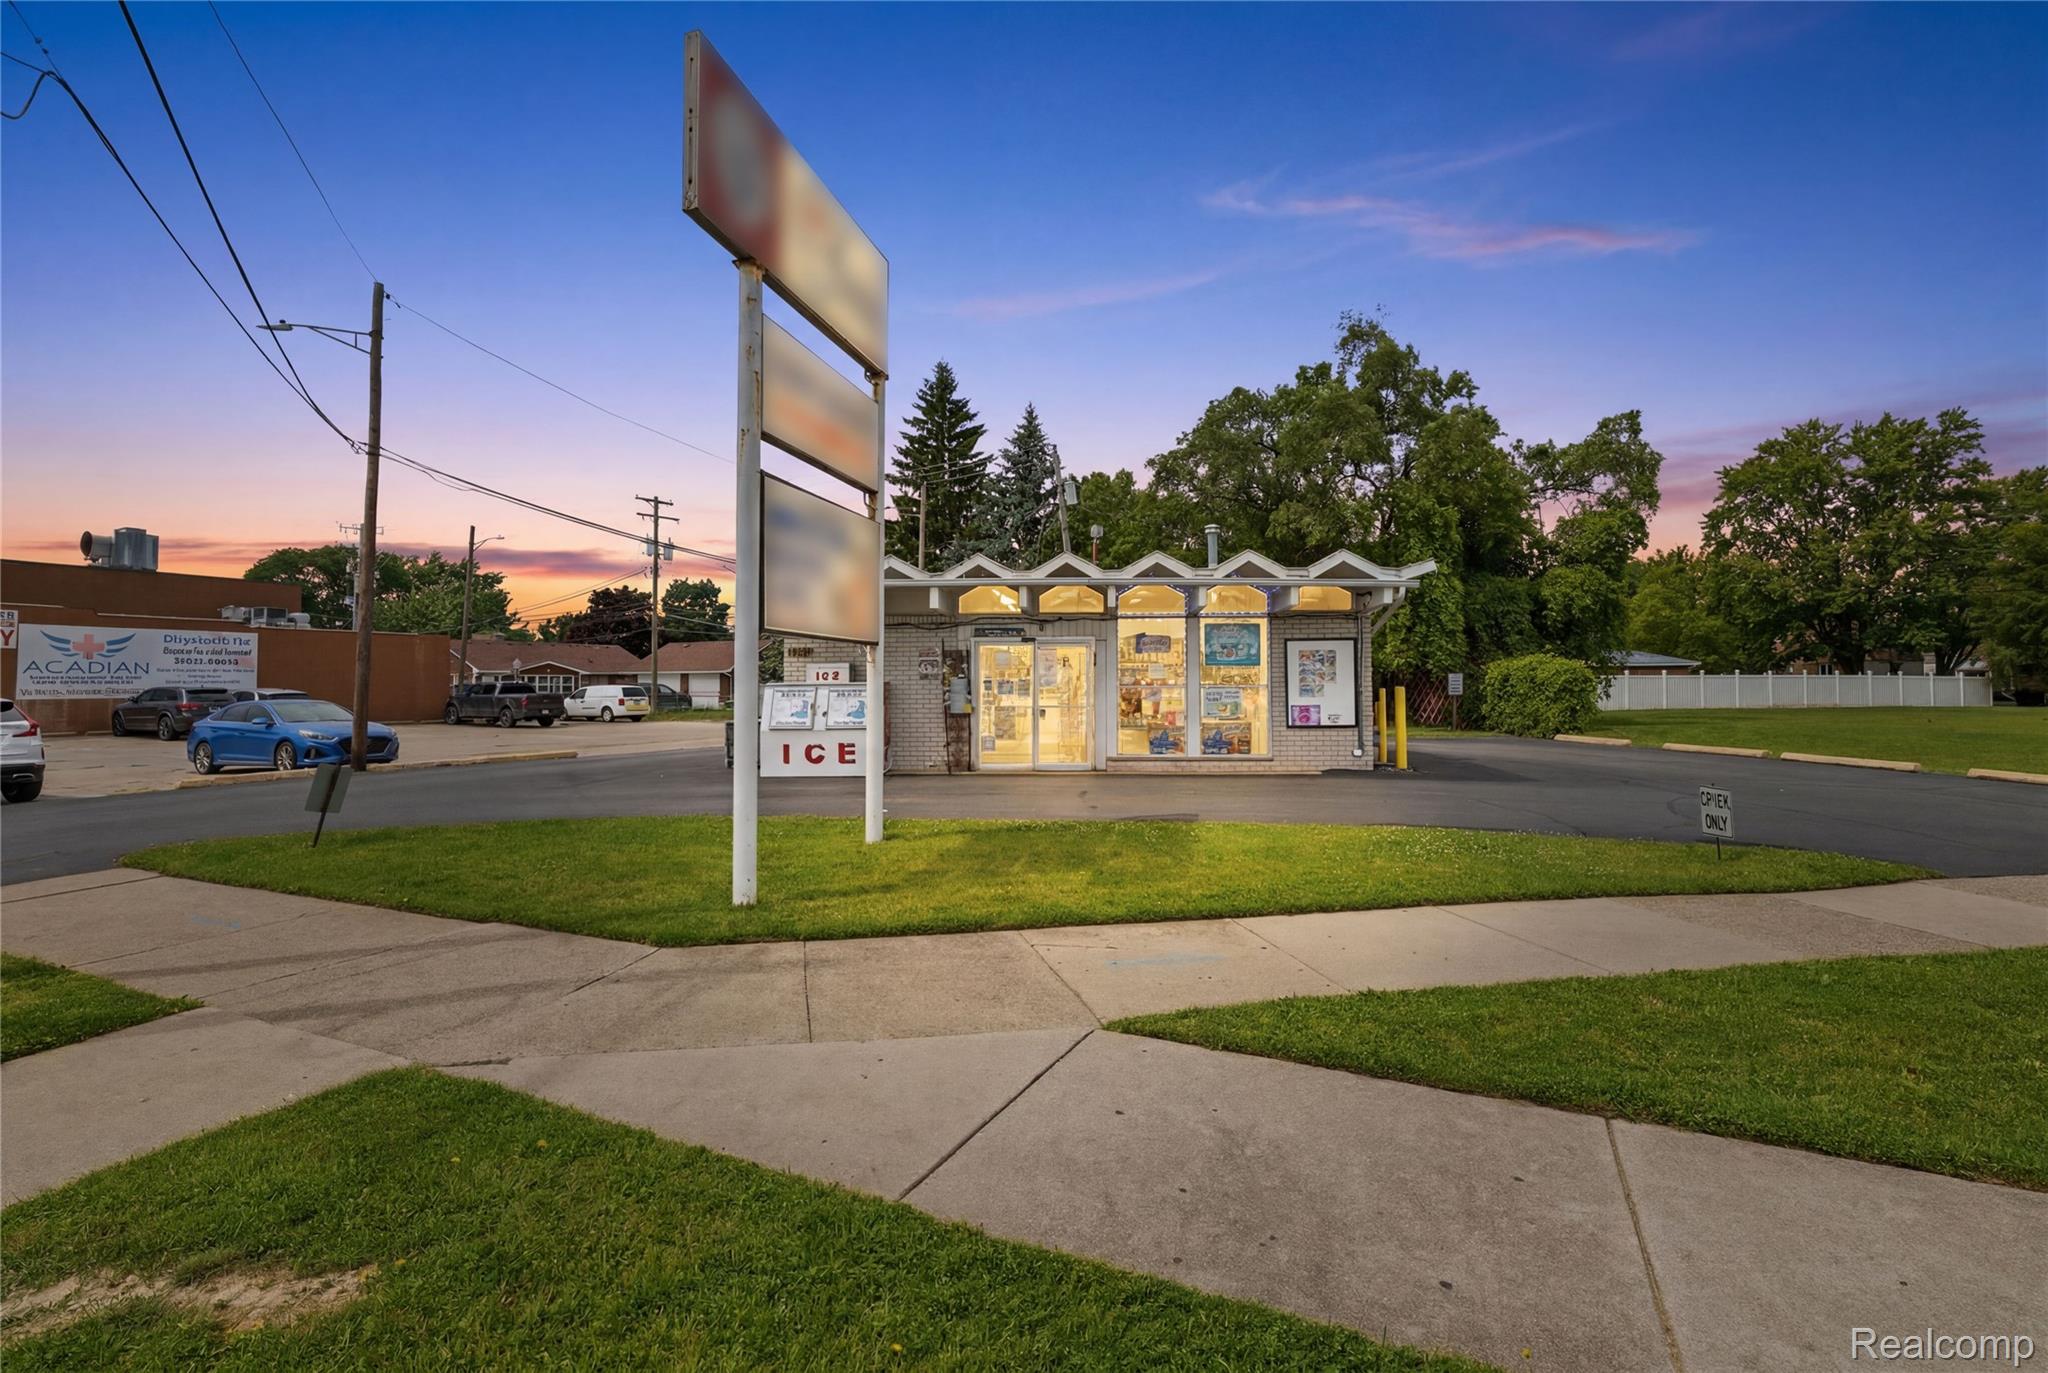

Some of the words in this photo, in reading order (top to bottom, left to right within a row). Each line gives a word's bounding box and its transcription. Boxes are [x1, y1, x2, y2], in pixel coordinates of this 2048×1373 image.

[22, 660, 150, 674] ACADIAN
[782, 742, 857, 765] ICE
[1705, 813, 1728, 832] ONLY
